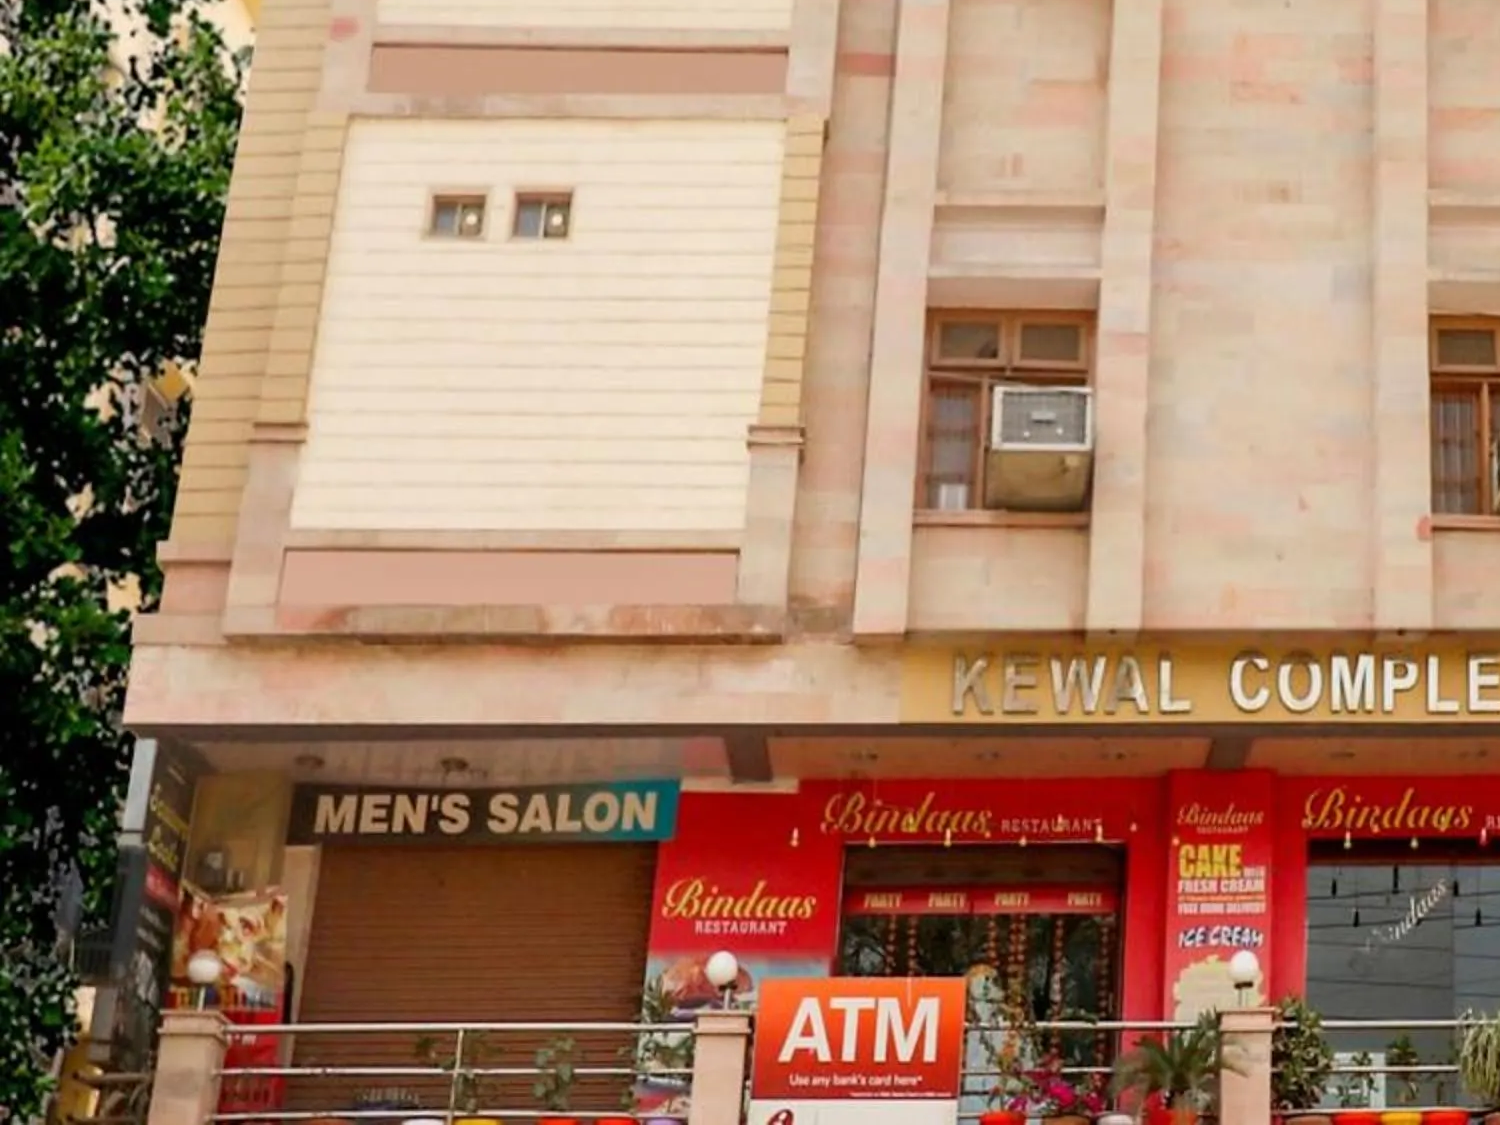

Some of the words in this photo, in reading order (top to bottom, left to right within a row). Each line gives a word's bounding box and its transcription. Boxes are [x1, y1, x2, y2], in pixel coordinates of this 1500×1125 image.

[950, 651, 1192, 715] KEWAL
[314, 792, 471, 835] MEN'S
[487, 790, 659, 834] SALON
[820, 791, 992, 834] Bindaas
[1001, 818, 1103, 834] RESTAURANT
[1177, 801, 1264, 825] Bindaas
[1301, 786, 1473, 830] Bindaas
[1179, 844, 1242, 879] CAKE
[661, 876, 816, 918] Bindaas
[1178, 879, 1217, 893] FRESH
[1221, 878, 1265, 893] CREAM
[695, 920, 787, 935] RESTAURANT
[1178, 928, 1207, 948] ICE
[1209, 924, 1264, 948] CREAM
[778, 996, 940, 1063] ATM
[789, 1074, 808, 1086] Use
[811, 1077, 831, 1089] any
[833, 1074, 866, 1086] bank's
[868, 1074, 892, 1086] card
